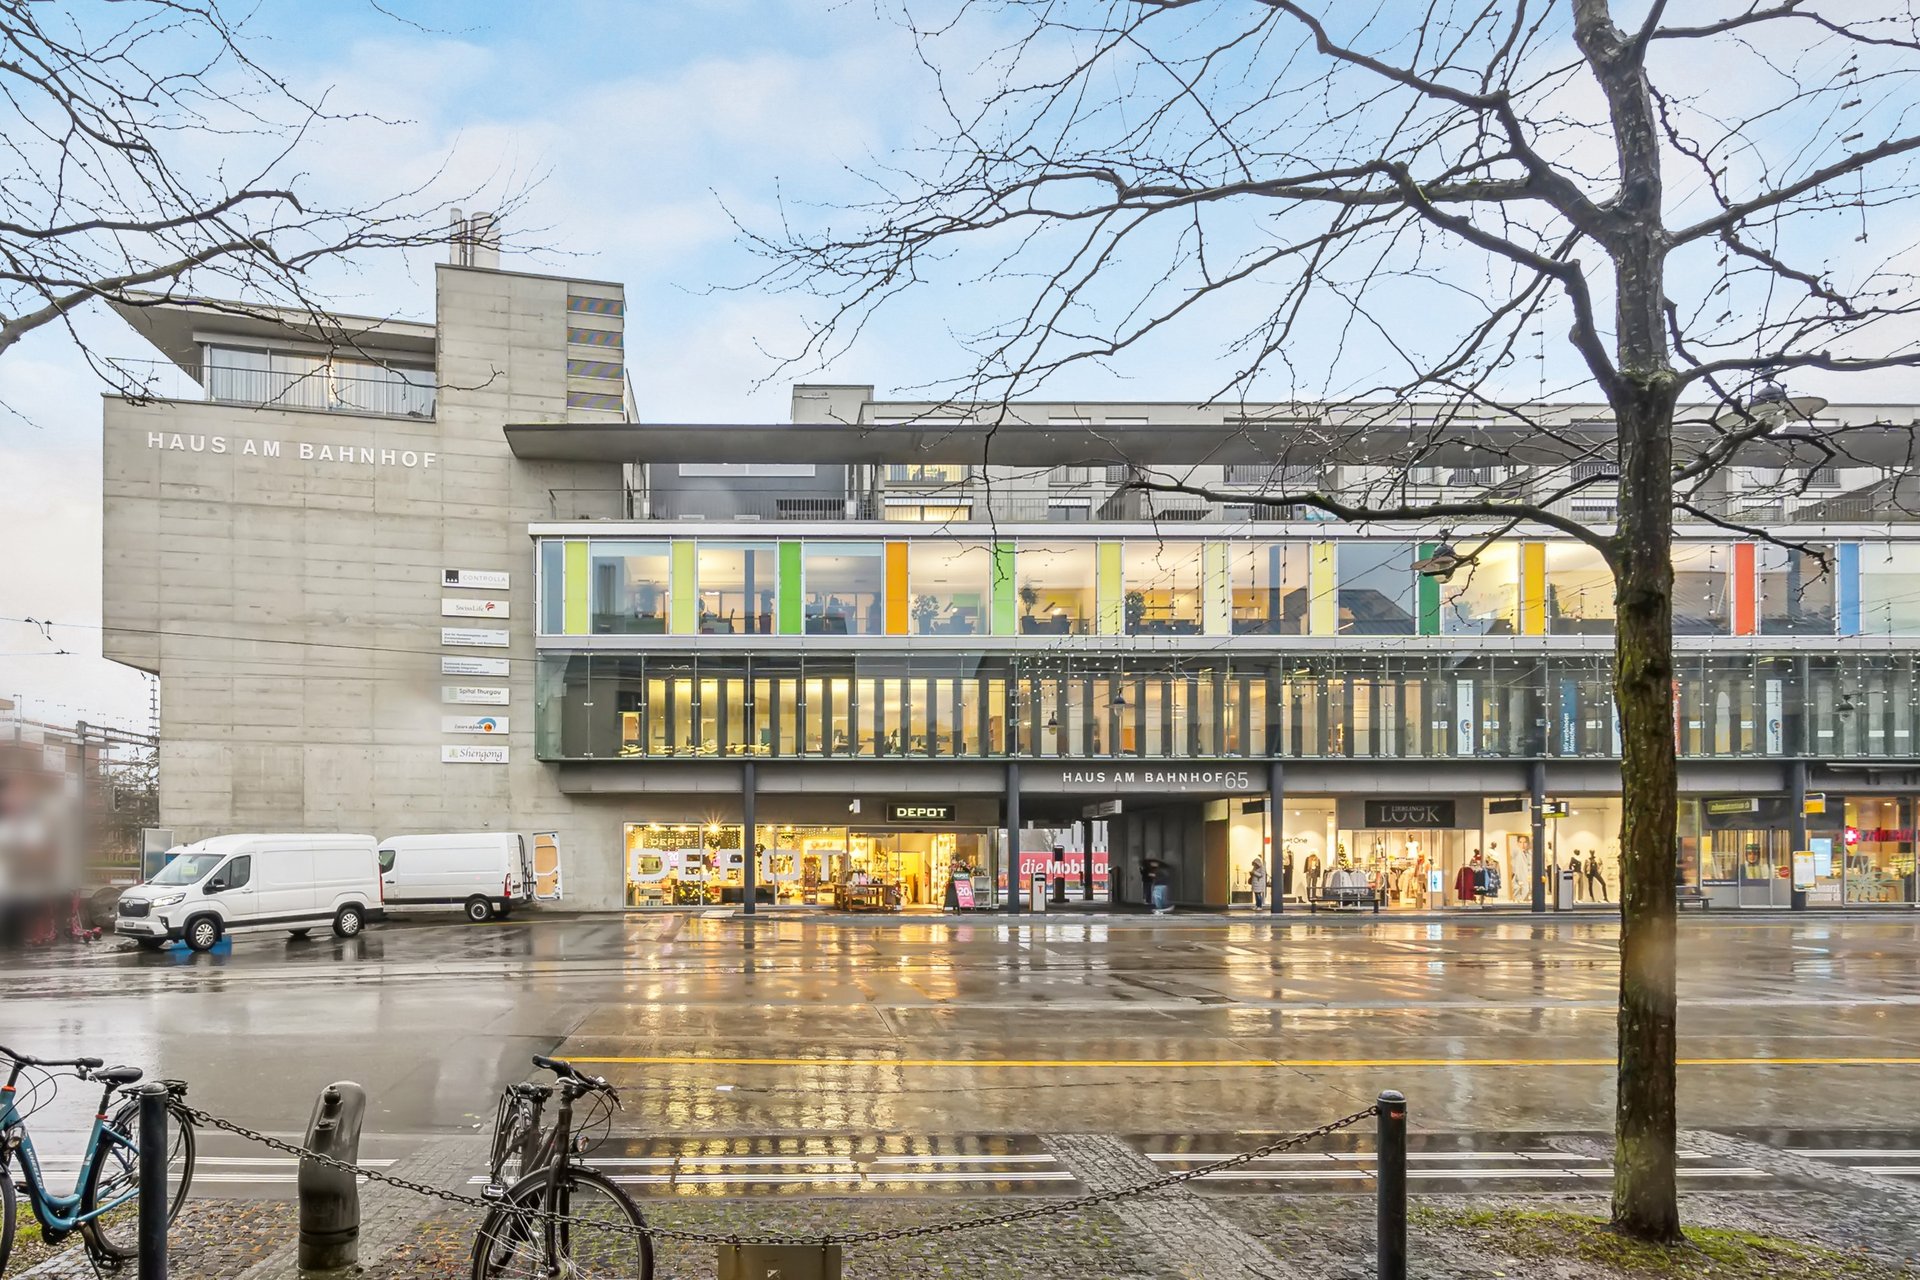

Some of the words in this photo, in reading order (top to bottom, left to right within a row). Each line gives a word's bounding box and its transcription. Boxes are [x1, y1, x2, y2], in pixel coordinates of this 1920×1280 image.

[147, 431, 227, 454] HAUS
[242, 439, 281, 458] AM
[299, 443, 437, 468] BAHNHOF
[477, 688, 501, 696] Thurgau
[460, 747, 503, 762] Shengong
[1062, 772, 1106, 783] HAUS
[1113, 772, 1136, 783] AM
[1144, 772, 1223, 783] BAHNHOF
[1224, 771, 1249, 789] 65
[896, 807, 947, 817] DEPOT
[650, 838, 693, 846] DEPOT
[629, 847, 847, 881] DEPOT
[1021, 858, 1044, 875] die
